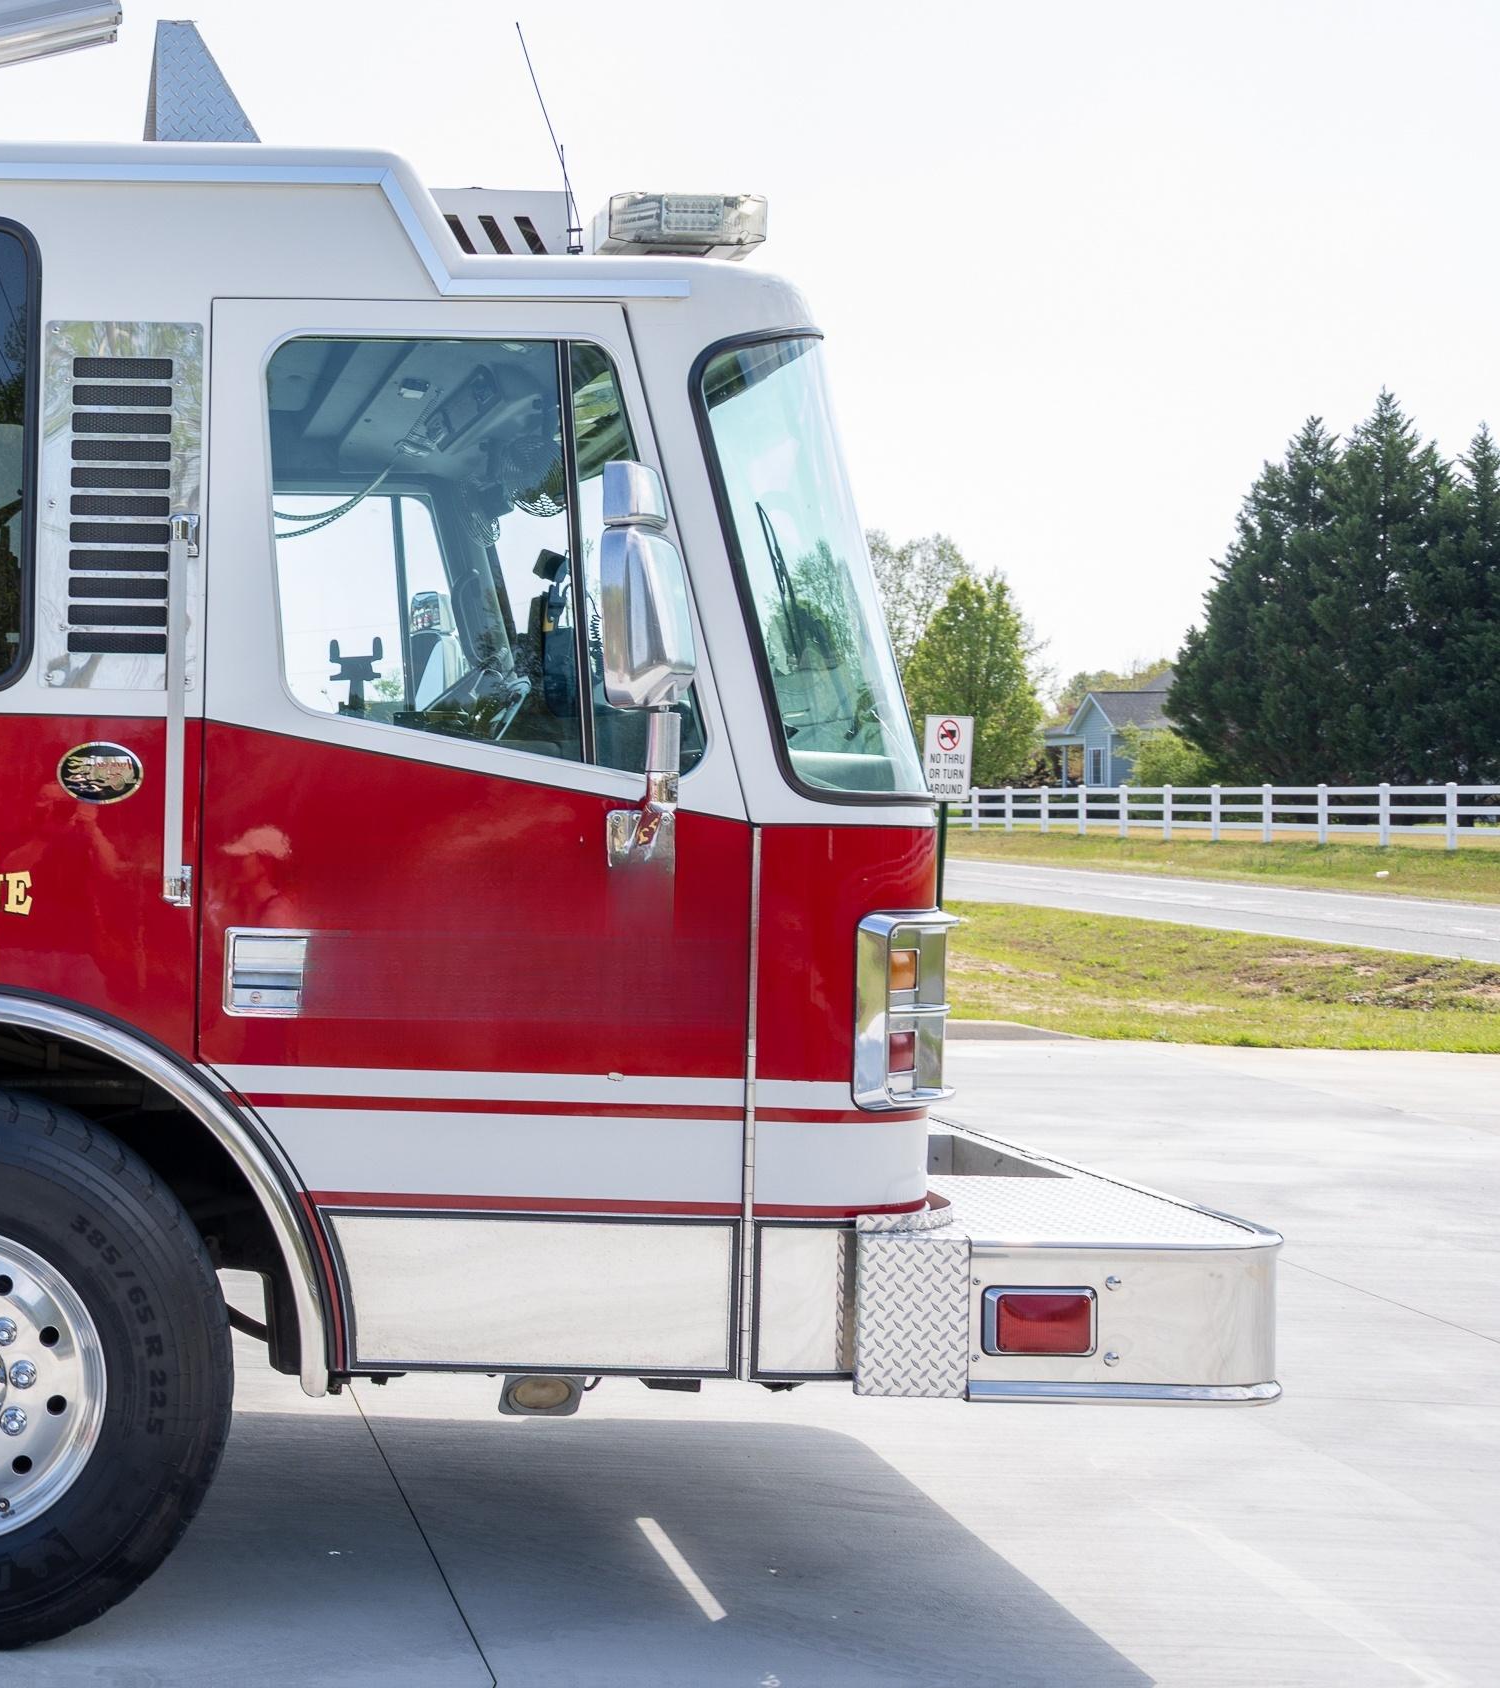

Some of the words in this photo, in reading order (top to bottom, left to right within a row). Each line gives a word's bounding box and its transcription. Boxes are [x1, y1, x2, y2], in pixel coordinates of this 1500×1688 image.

[930, 753, 941, 764] NO
[943, 753, 965, 765] THRU
[929, 768, 940, 779] OR
[942, 768, 964, 779] TURN
